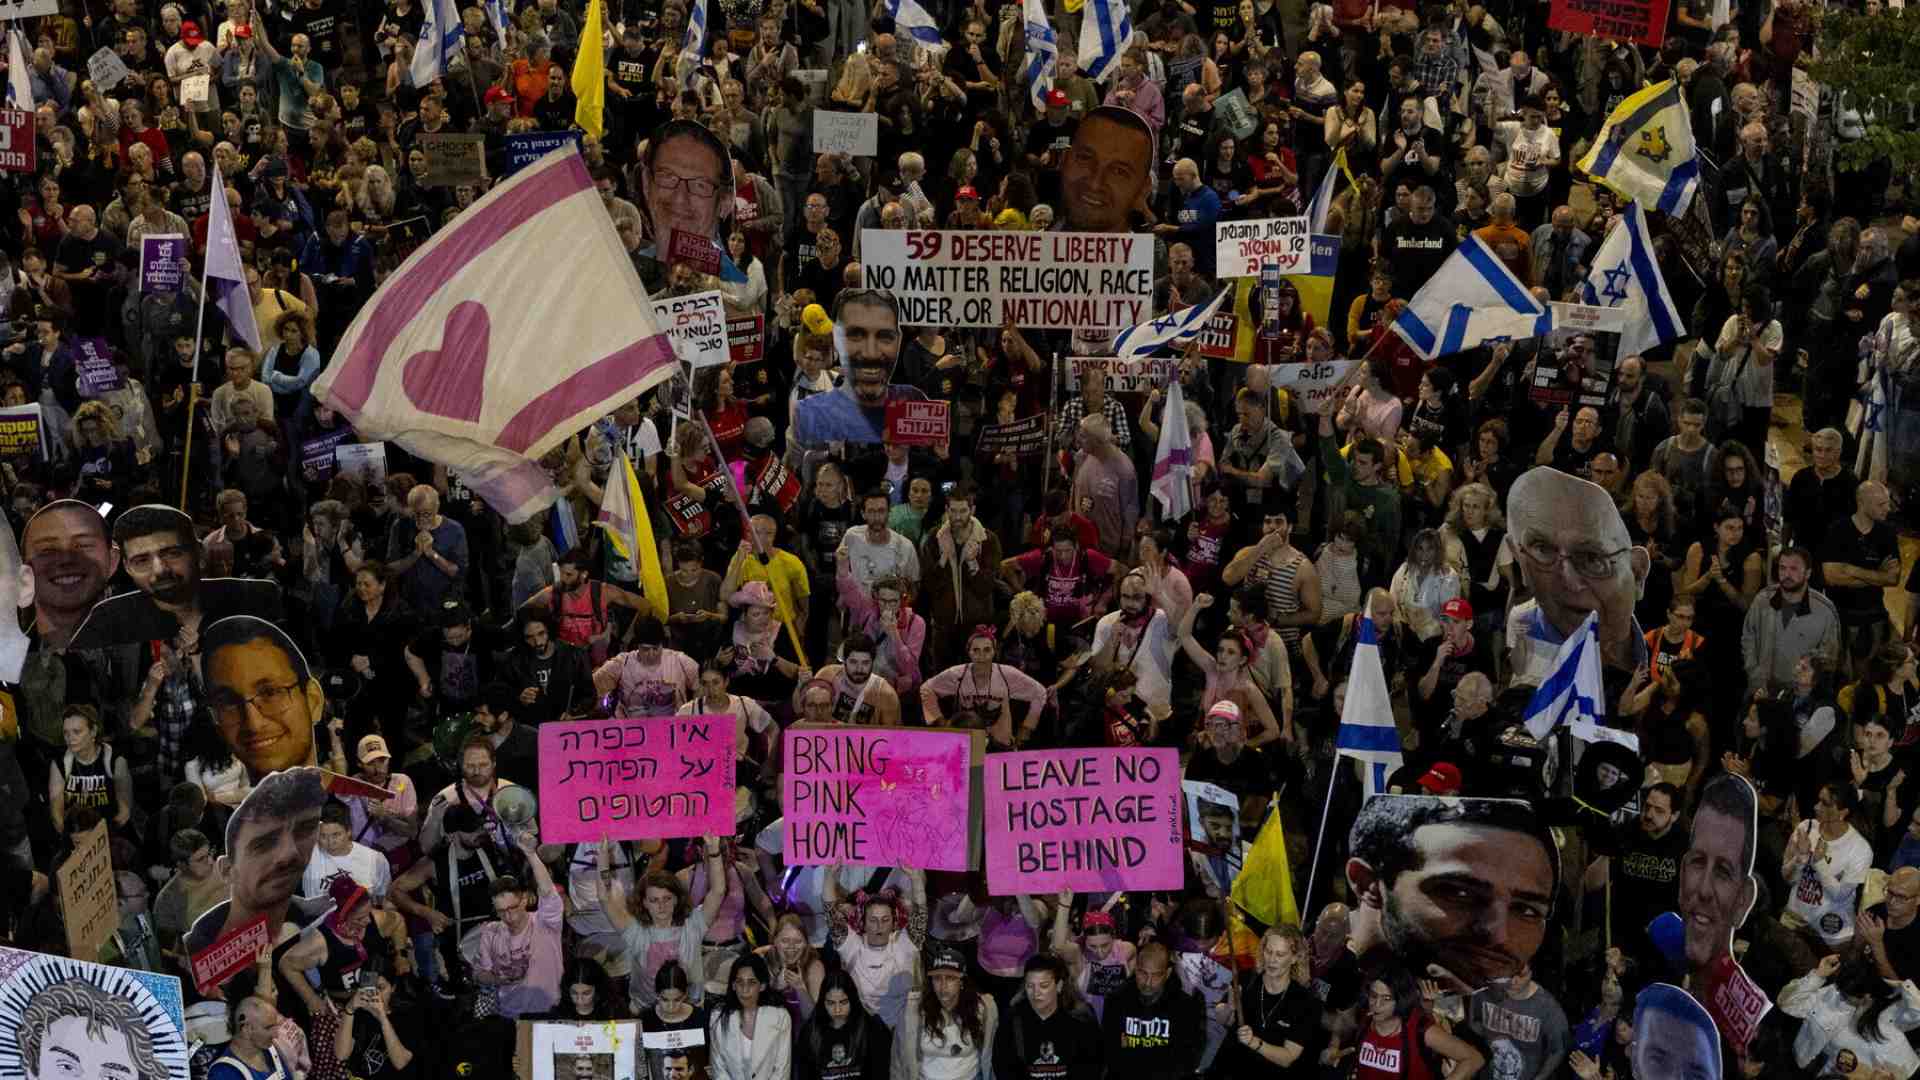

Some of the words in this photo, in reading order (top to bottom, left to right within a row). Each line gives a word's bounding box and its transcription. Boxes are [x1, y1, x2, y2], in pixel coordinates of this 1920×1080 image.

[907, 231, 942, 260] 59
[951, 235, 1042, 262] DESERVE
[1054, 237, 1135, 263] LIBERTY
[1396, 234, 1443, 250] Timberland
[866, 265, 896, 290] NO
[903, 266, 989, 293] MATTER
[1000, 268, 1093, 297] RELIGION,
[1100, 269, 1154, 297] RACE,
[898, 297, 960, 326] NDER,
[963, 299, 992, 324] OR
[1002, 299, 1143, 328] NATIONALITY
[905, 401, 946, 418] עדיין
[559, 724, 647, 752] כפרה
[668, 722, 712, 750] אין
[679, 754, 716, 780] על
[793, 734, 891, 777] BRING
[559, 758, 658, 787] הפקרת
[1002, 757, 1101, 791] LEAVE
[1114, 755, 1161, 785] NO
[577, 790, 710, 823] החטופים
[793, 780, 868, 818] PINK
[1008, 795, 1157, 832] HOSTAGE
[793, 821, 868, 861] HOME
[1018, 836, 1147, 874] BEHIND
